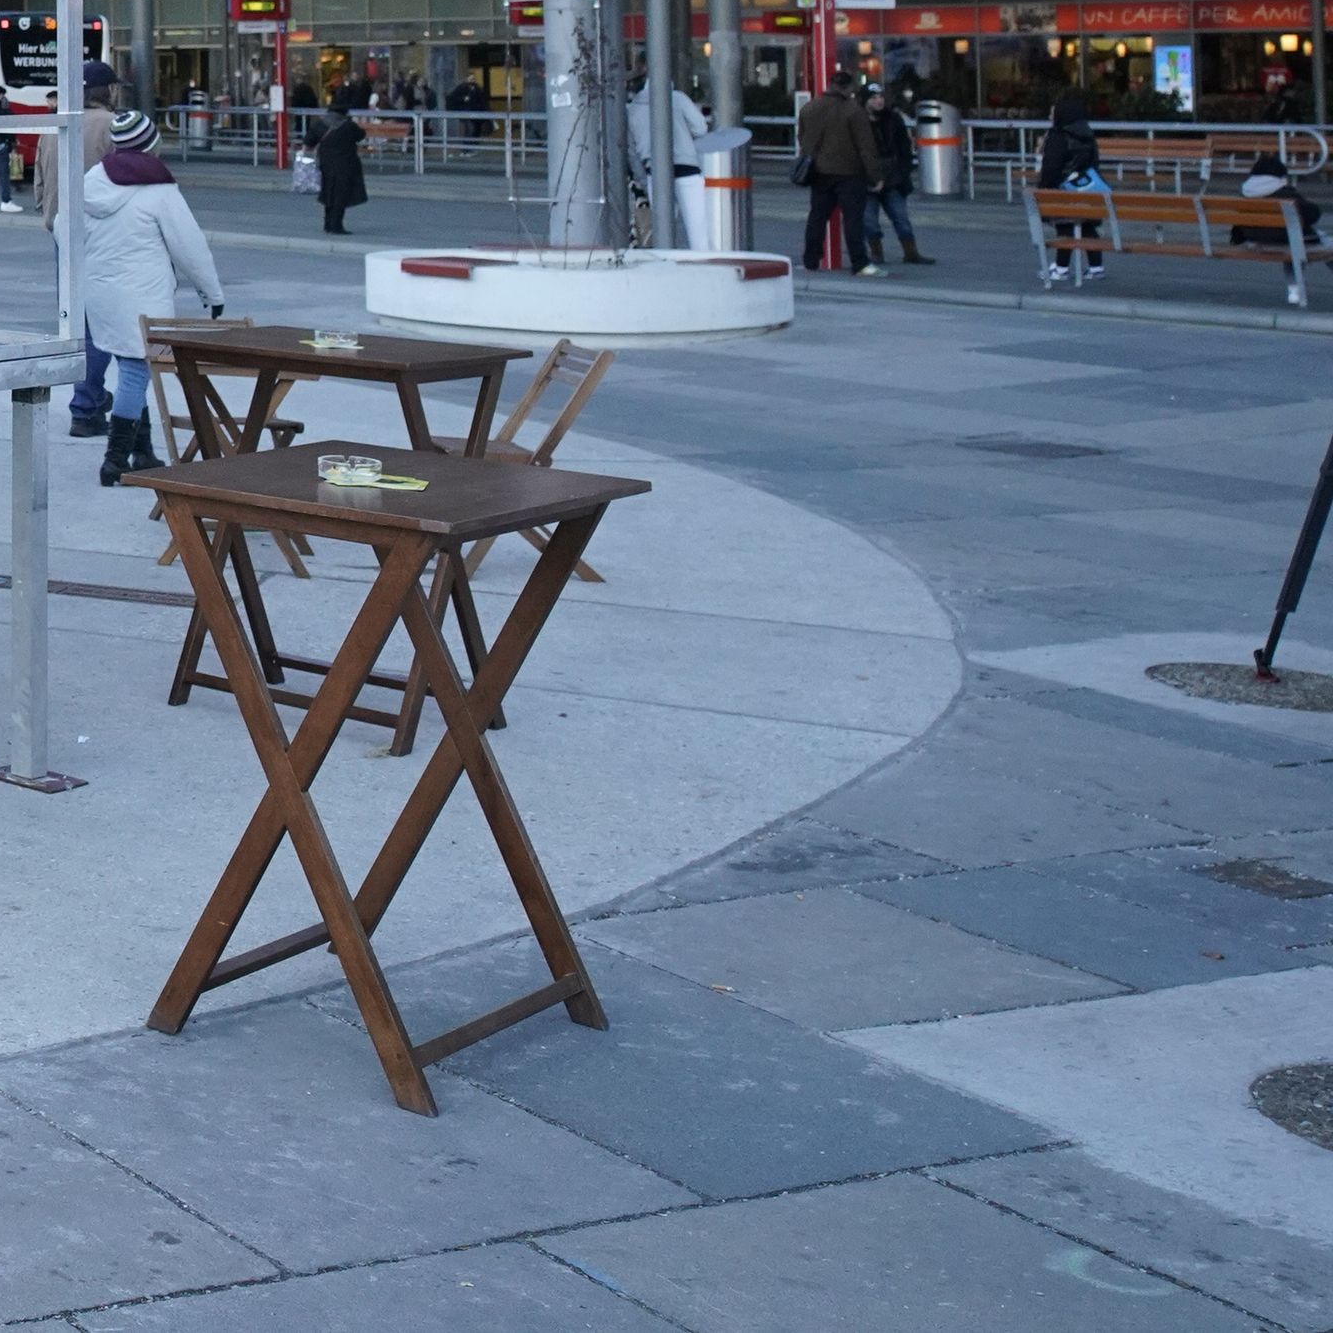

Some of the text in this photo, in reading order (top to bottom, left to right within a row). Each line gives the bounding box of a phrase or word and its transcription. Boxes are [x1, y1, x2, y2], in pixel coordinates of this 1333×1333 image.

[1084, 11, 1113, 24] UN
[1198, 8, 1244, 23] PER
[18, 43, 38, 54] Hier
